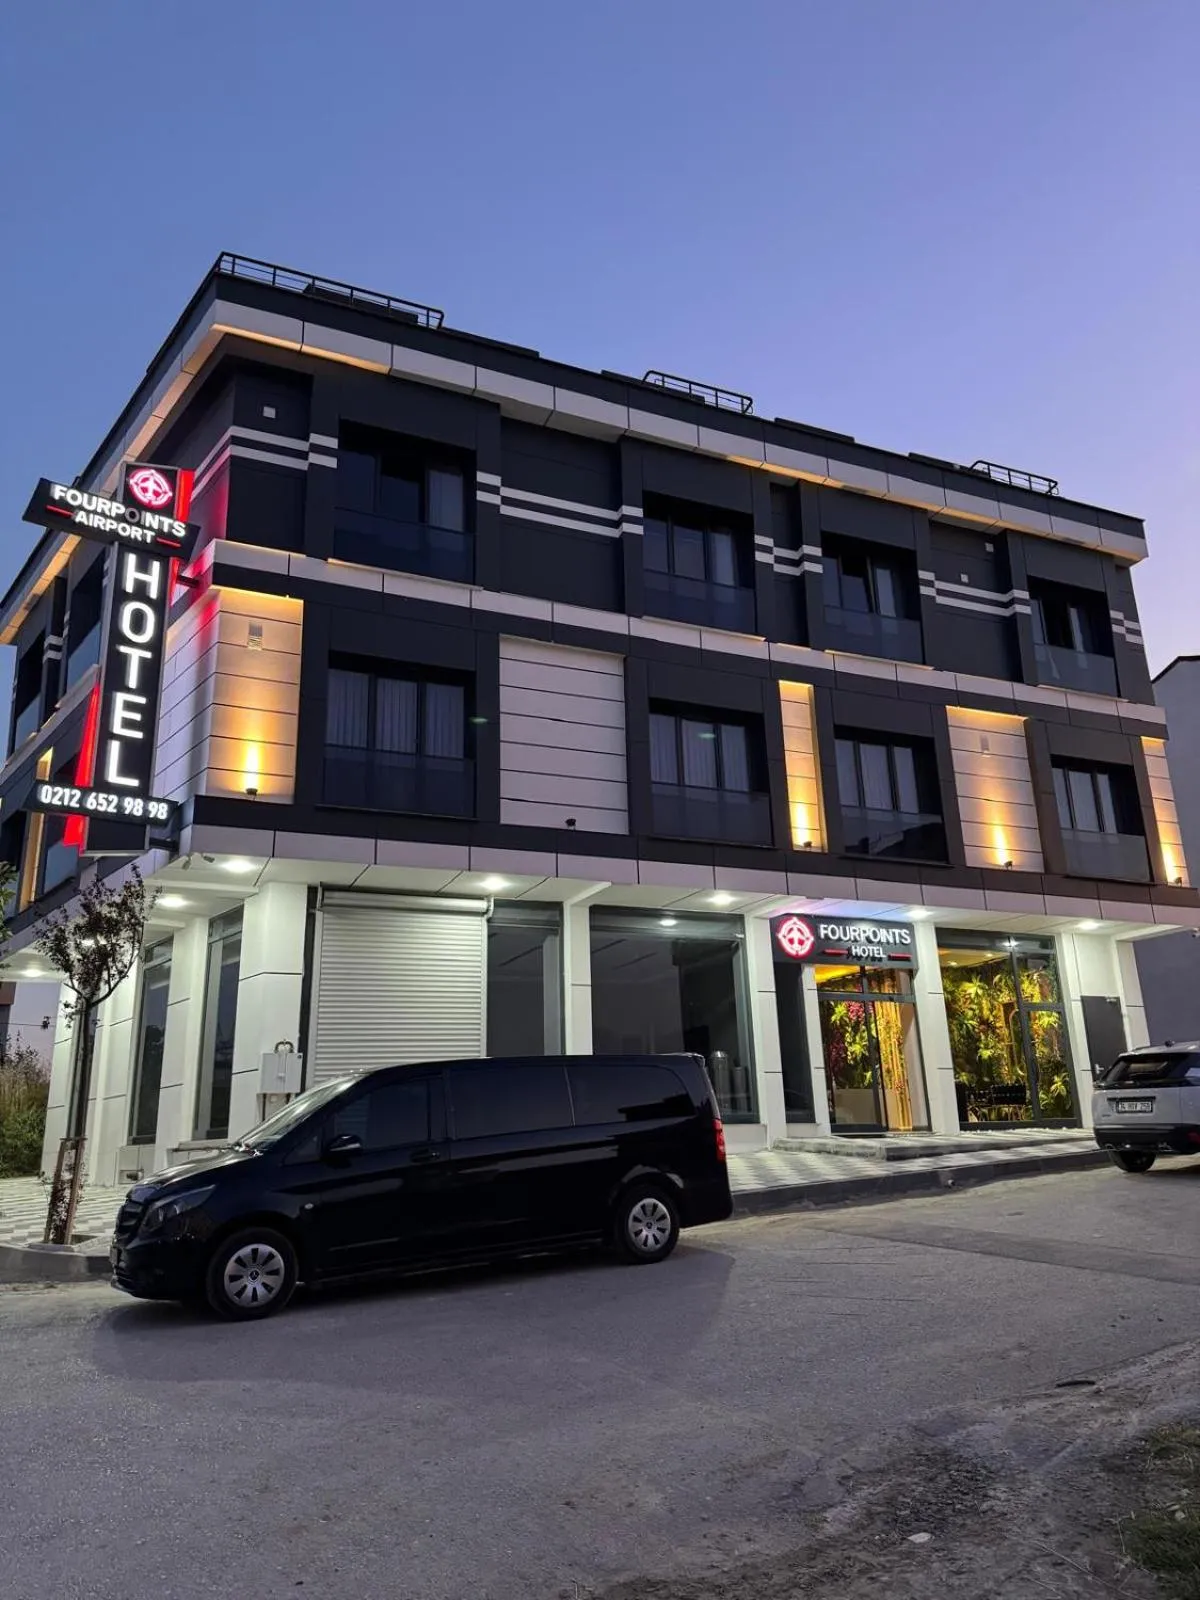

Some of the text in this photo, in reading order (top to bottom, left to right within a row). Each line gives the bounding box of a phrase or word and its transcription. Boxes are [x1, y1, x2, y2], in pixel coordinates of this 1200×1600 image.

[52, 484, 187, 537] FOURPOINTS
[74, 510, 156, 544] AIRPORT
[107, 552, 161, 787] HOTEL
[40, 784, 169, 820] 0212 652 98 98
[819, 923, 912, 945] FOURPOINTS
[852, 945, 887, 958] HOTEL
